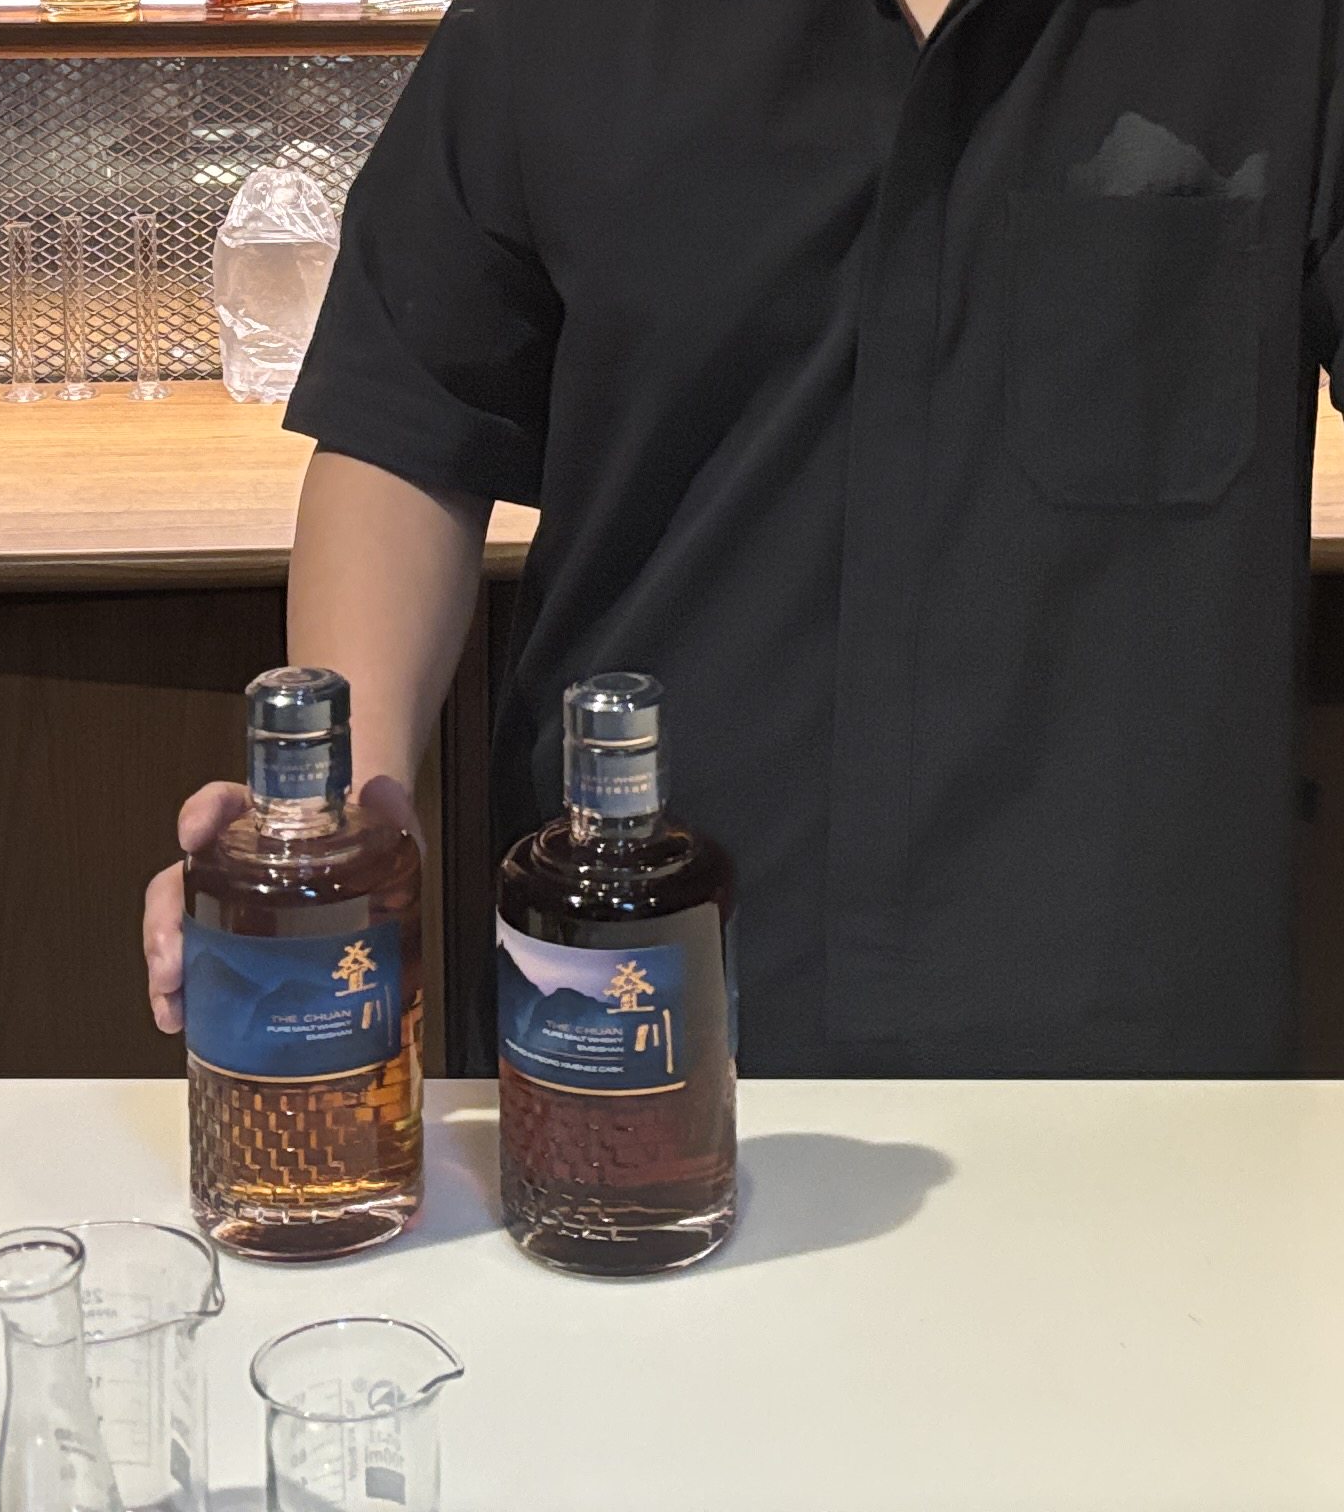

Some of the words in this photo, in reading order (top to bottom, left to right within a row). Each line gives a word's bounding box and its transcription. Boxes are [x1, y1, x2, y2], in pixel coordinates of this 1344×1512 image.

[271, 1014, 298, 1024] THE
[303, 1009, 352, 1023] CHUAN
[544, 1019, 570, 1032] THE
[575, 1026, 624, 1036] CHUAN
[598, 1066, 625, 1074] CASK
